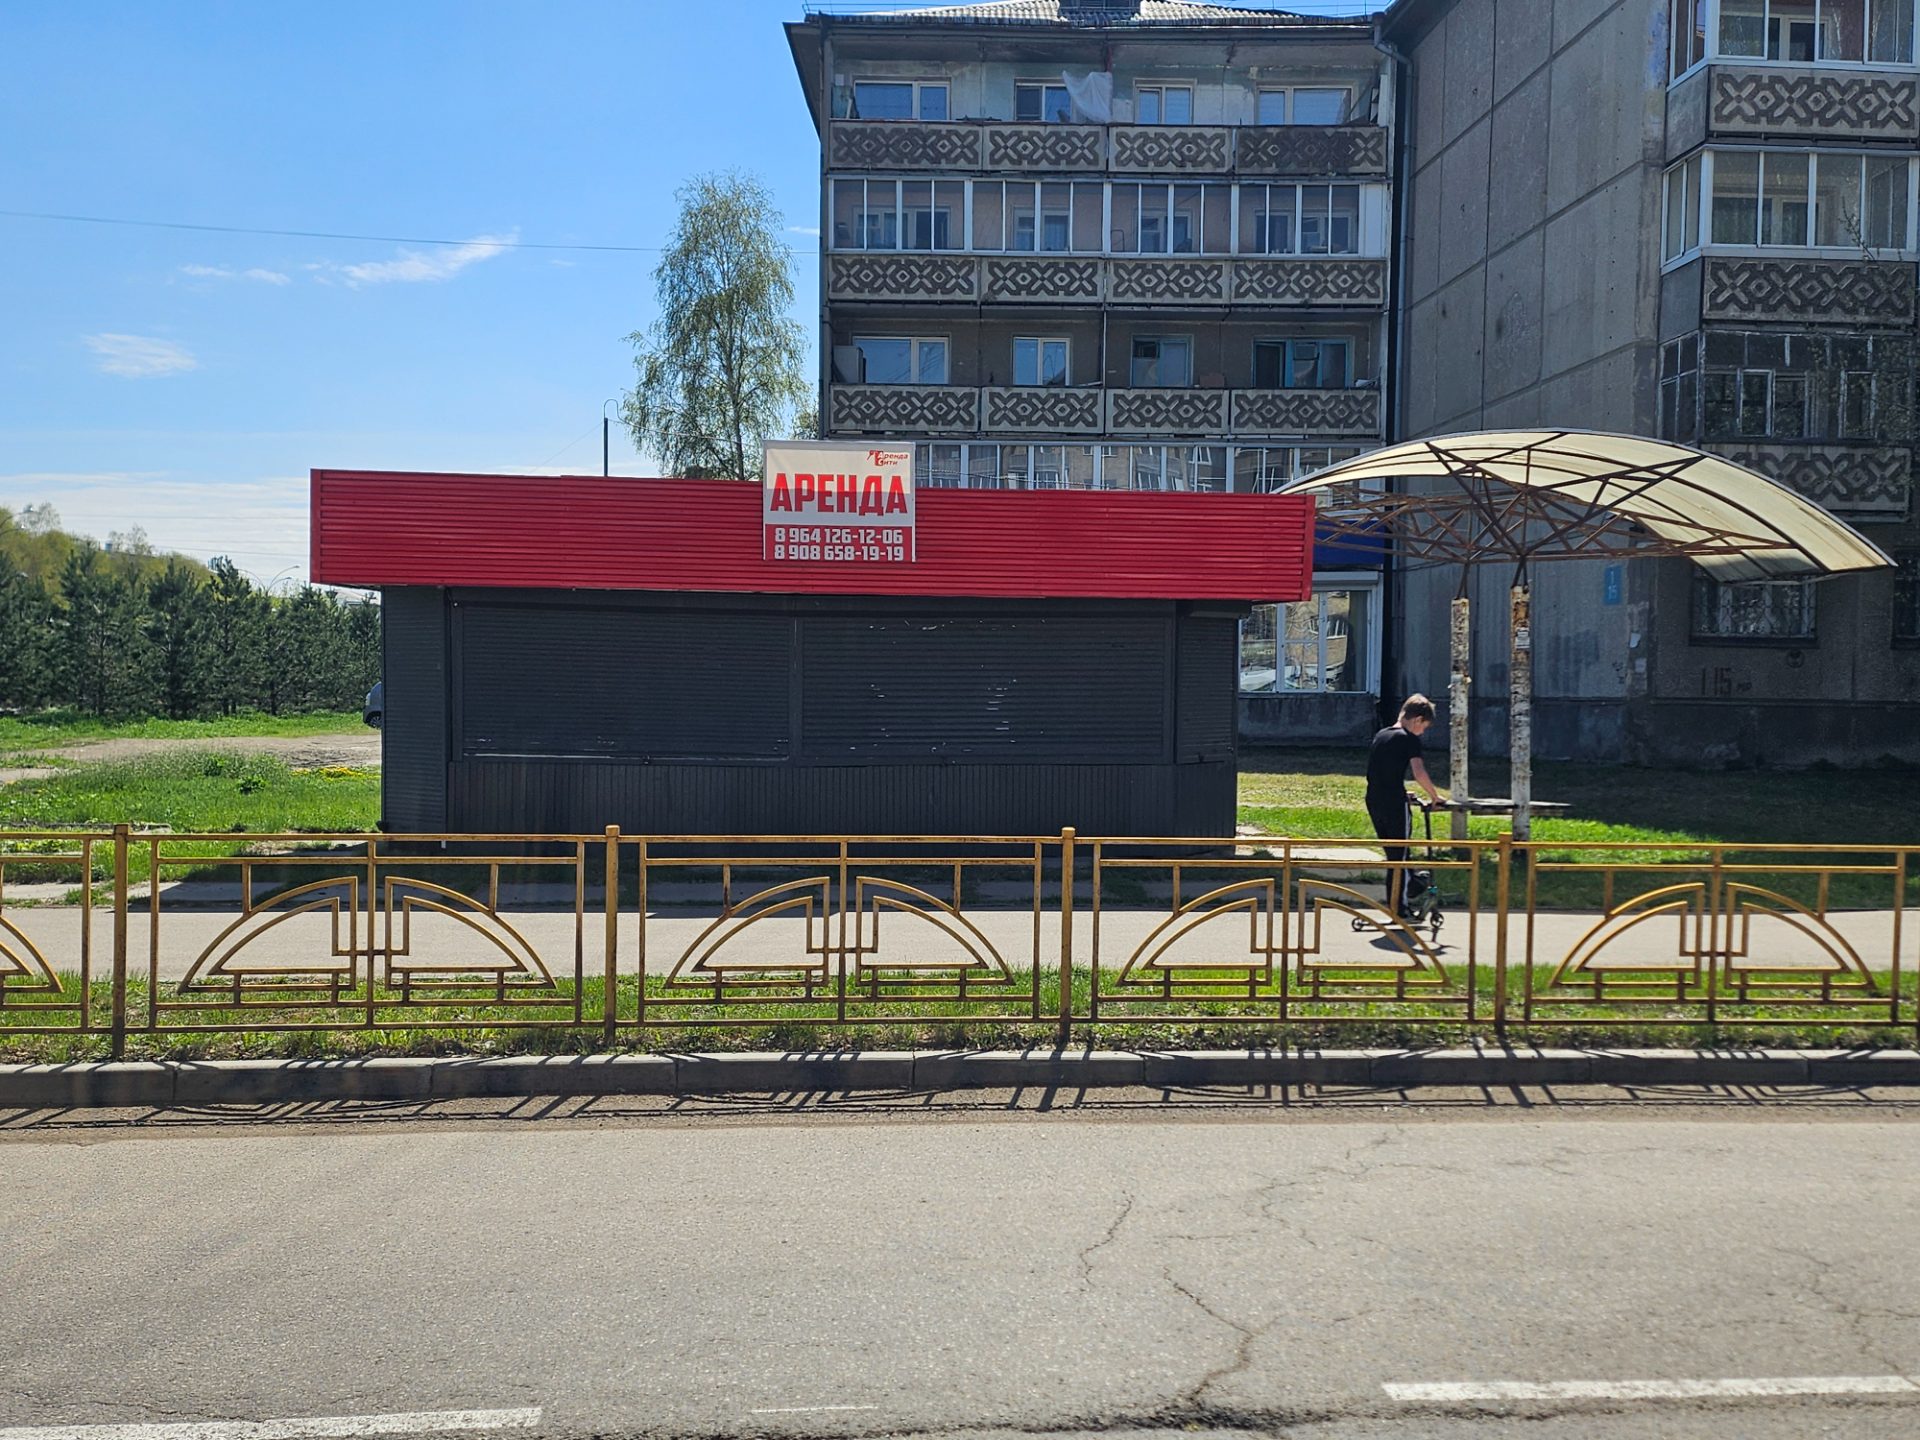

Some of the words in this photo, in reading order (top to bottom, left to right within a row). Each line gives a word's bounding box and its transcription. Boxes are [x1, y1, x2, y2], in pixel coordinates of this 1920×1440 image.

[770, 473, 908, 516] АРЕНДА
[775, 528, 785, 542] 8
[789, 528, 821, 543] 964
[824, 528, 903, 544] 126-12-06
[774, 544, 785, 559] 8
[789, 545, 820, 560] 908
[824, 545, 904, 561] 658-19-19
